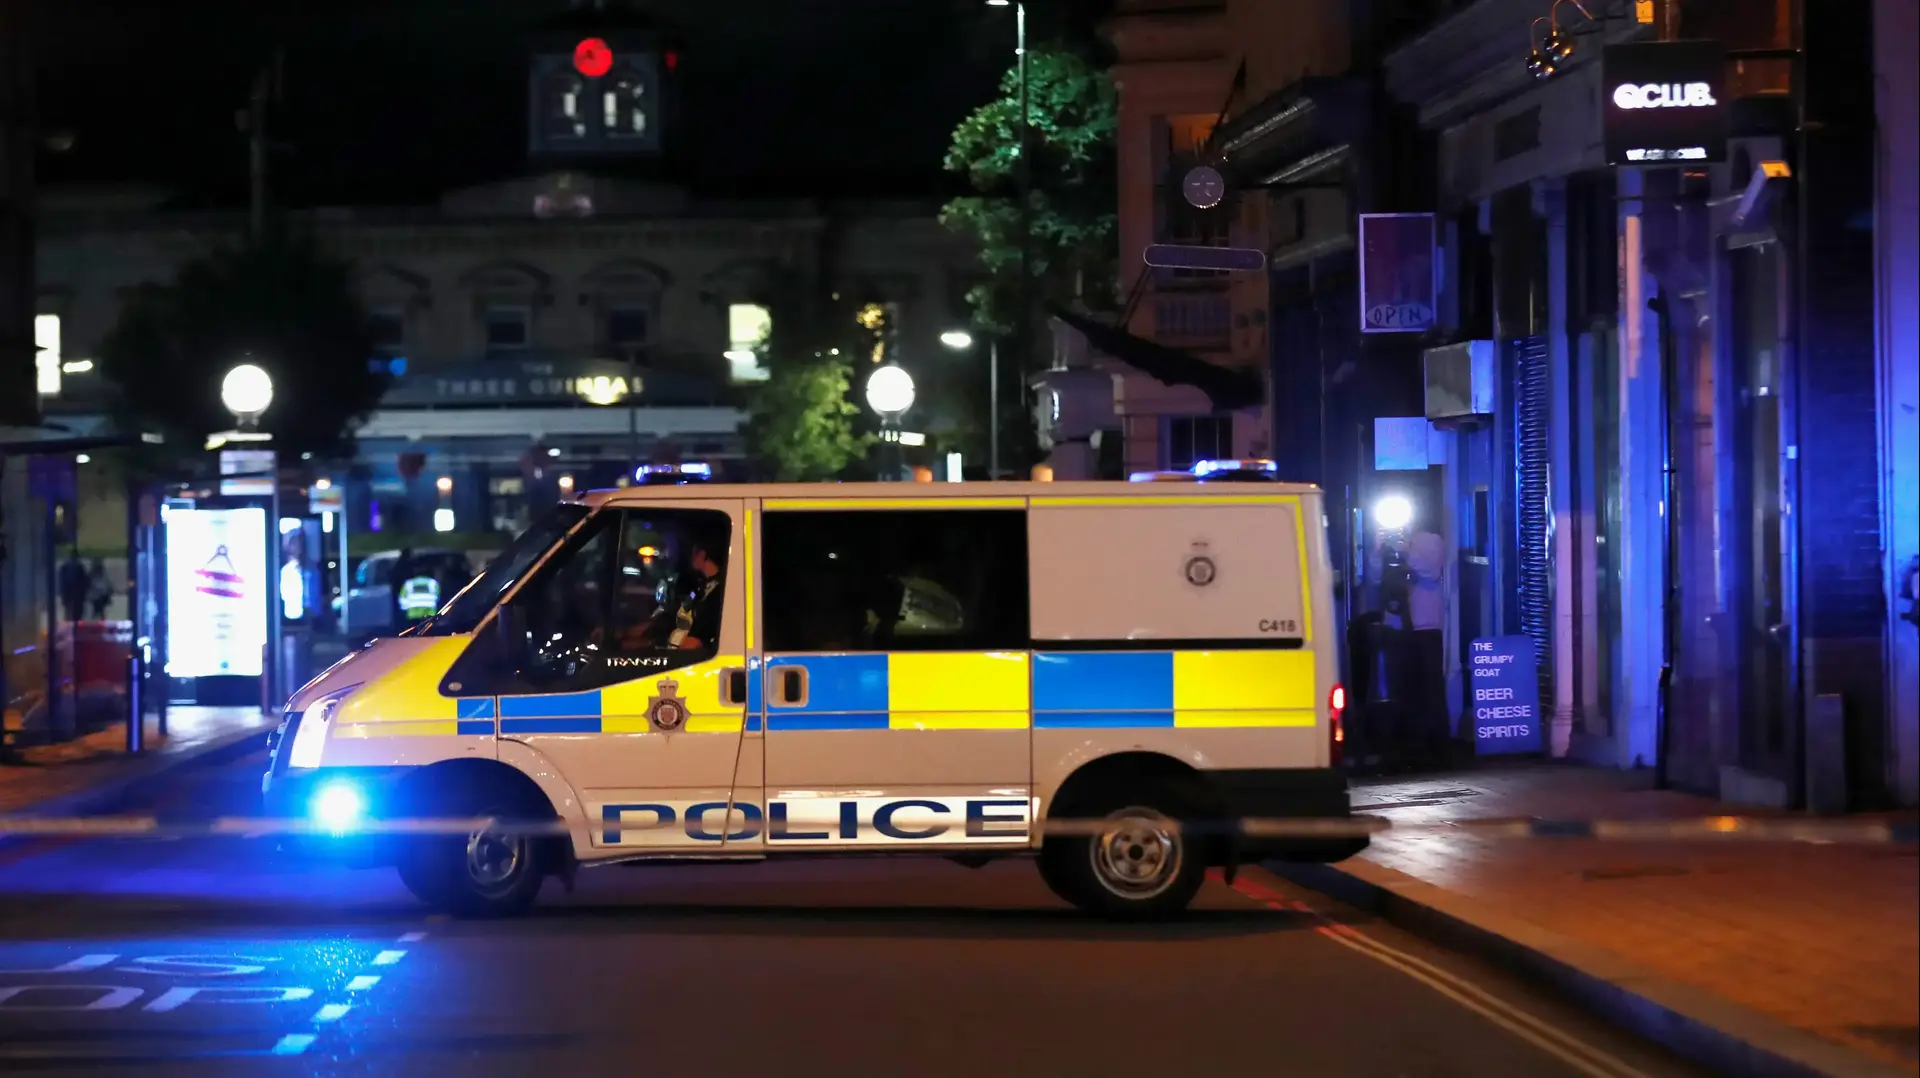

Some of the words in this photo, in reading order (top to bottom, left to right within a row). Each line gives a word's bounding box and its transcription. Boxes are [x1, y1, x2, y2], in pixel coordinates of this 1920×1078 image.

[1374, 305, 1422, 326] OPEN
[436, 378, 517, 397] THREE
[528, 376, 644, 396] GUINAS
[1473, 642, 1493, 651] THE
[606, 656, 669, 667] TRANSIT
[1474, 655, 1514, 664] GRUMPY
[1474, 668, 1500, 677] GOAT
[1476, 687, 1513, 700] BEER
[1477, 705, 1531, 719] CHEESE
[1478, 724, 1529, 738] SPIRITS
[602, 799, 1029, 844] POLICE
